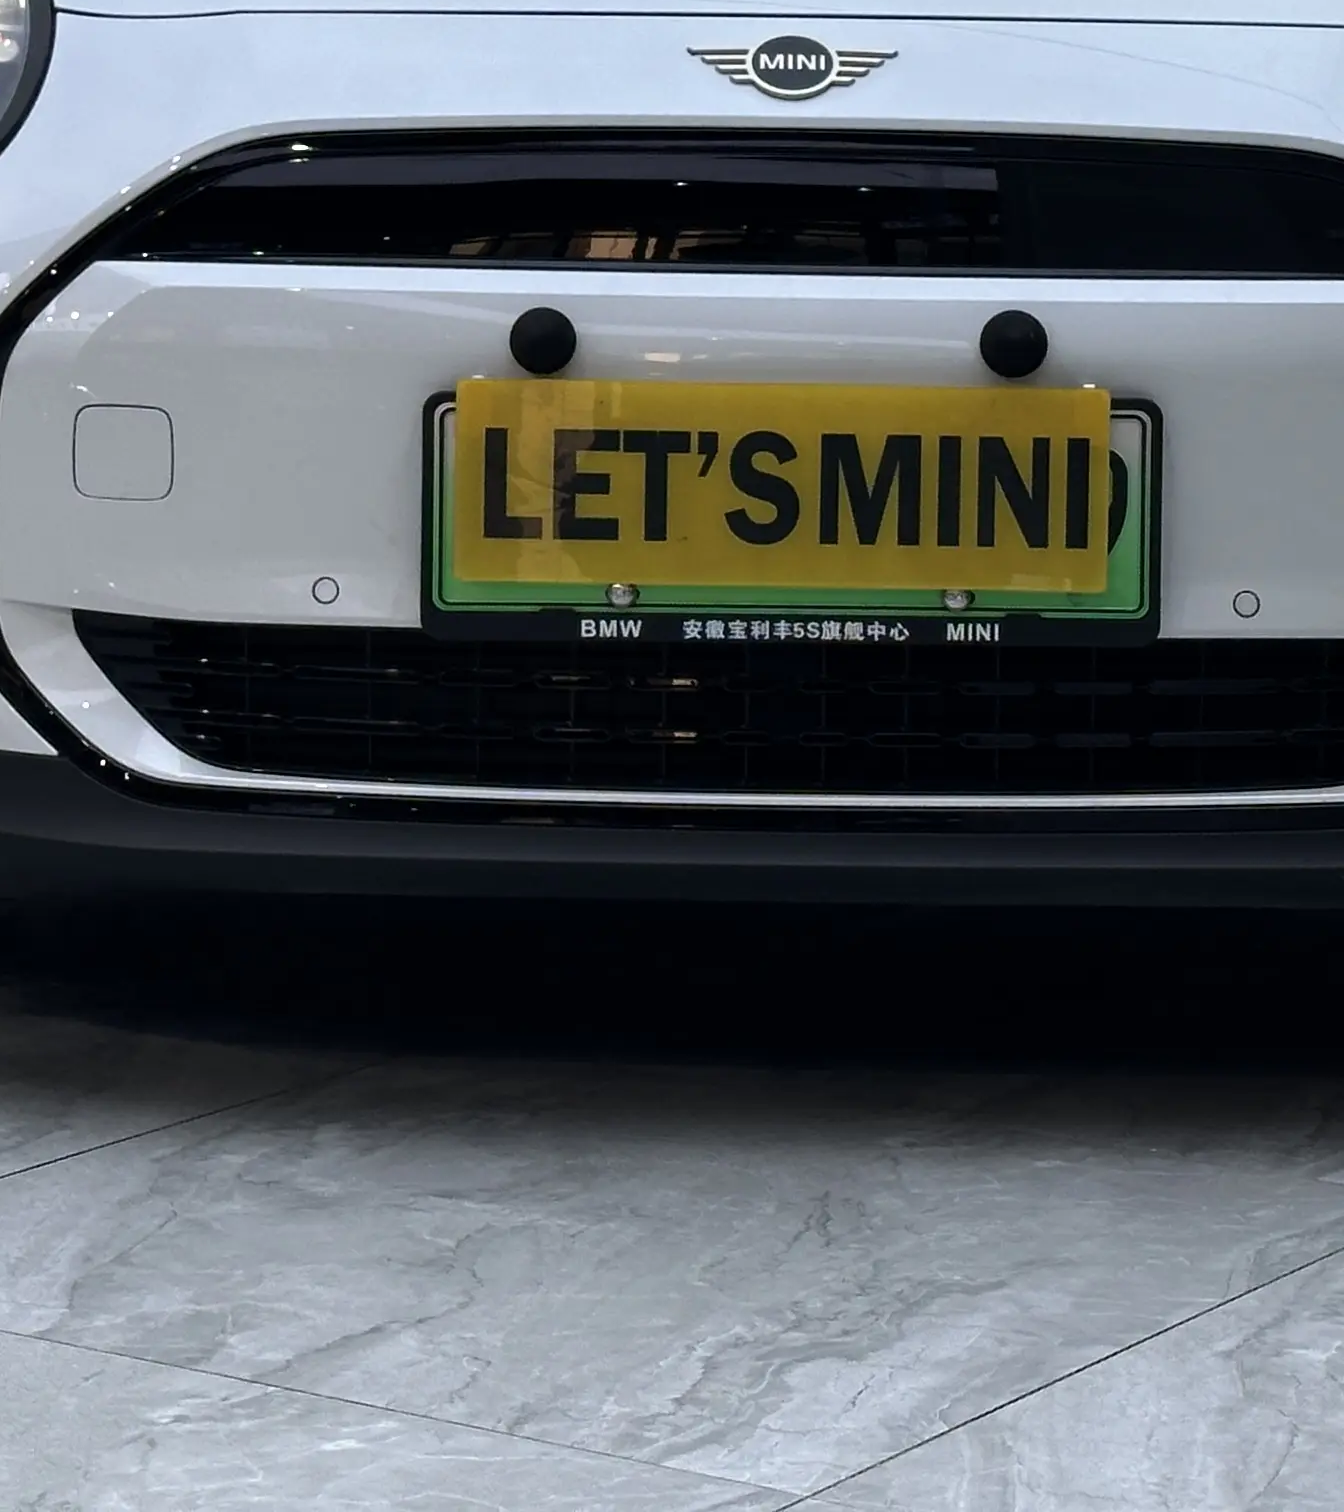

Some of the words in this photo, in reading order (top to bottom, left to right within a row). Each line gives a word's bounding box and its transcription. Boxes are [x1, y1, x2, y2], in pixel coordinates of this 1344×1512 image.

[759, 52, 826, 71] MINI
[580, 619, 643, 639] BMW
[682, 619, 911, 642] 安徽宝利丰5S旗舰中心
[946, 622, 1001, 642] MINI
